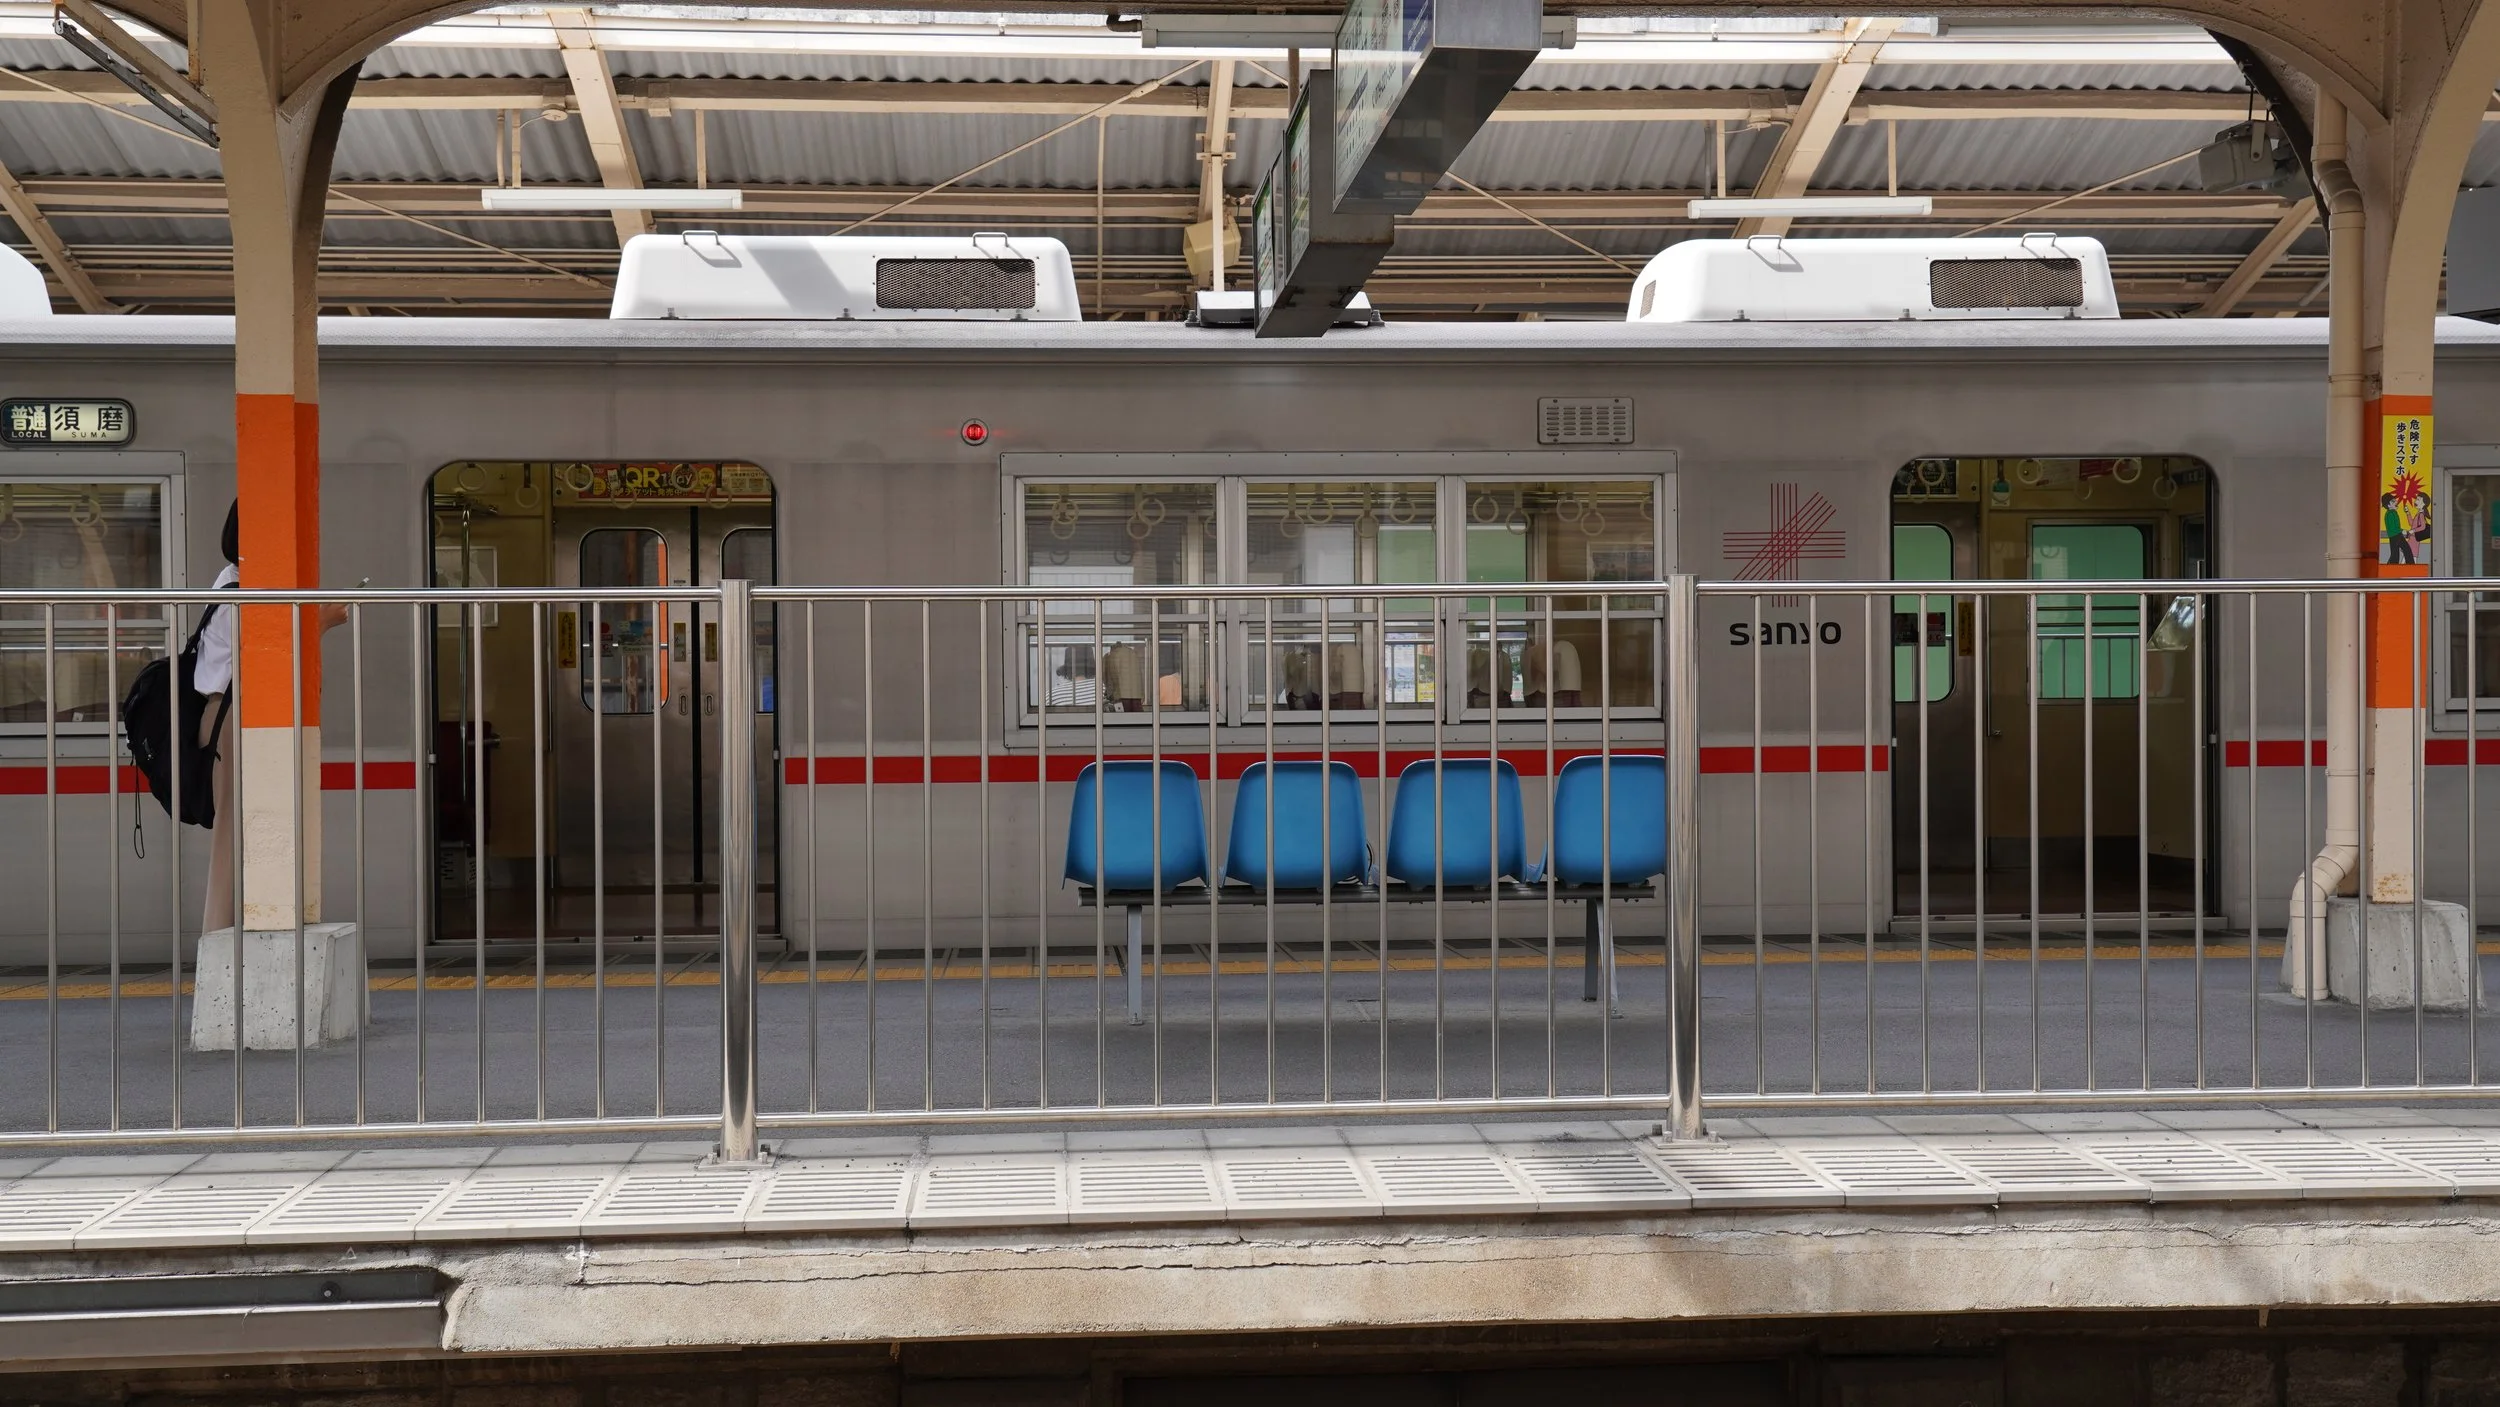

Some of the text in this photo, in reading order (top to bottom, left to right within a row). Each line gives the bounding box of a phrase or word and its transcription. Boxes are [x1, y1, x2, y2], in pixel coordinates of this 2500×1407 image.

[11, 405, 47, 431] 普通
[54, 406, 123, 431] 須磨
[2396, 422, 2407, 475] 歩きスマホ
[2409, 419, 2419, 465] 危険です
[1729, 621, 1842, 645] sanyo
